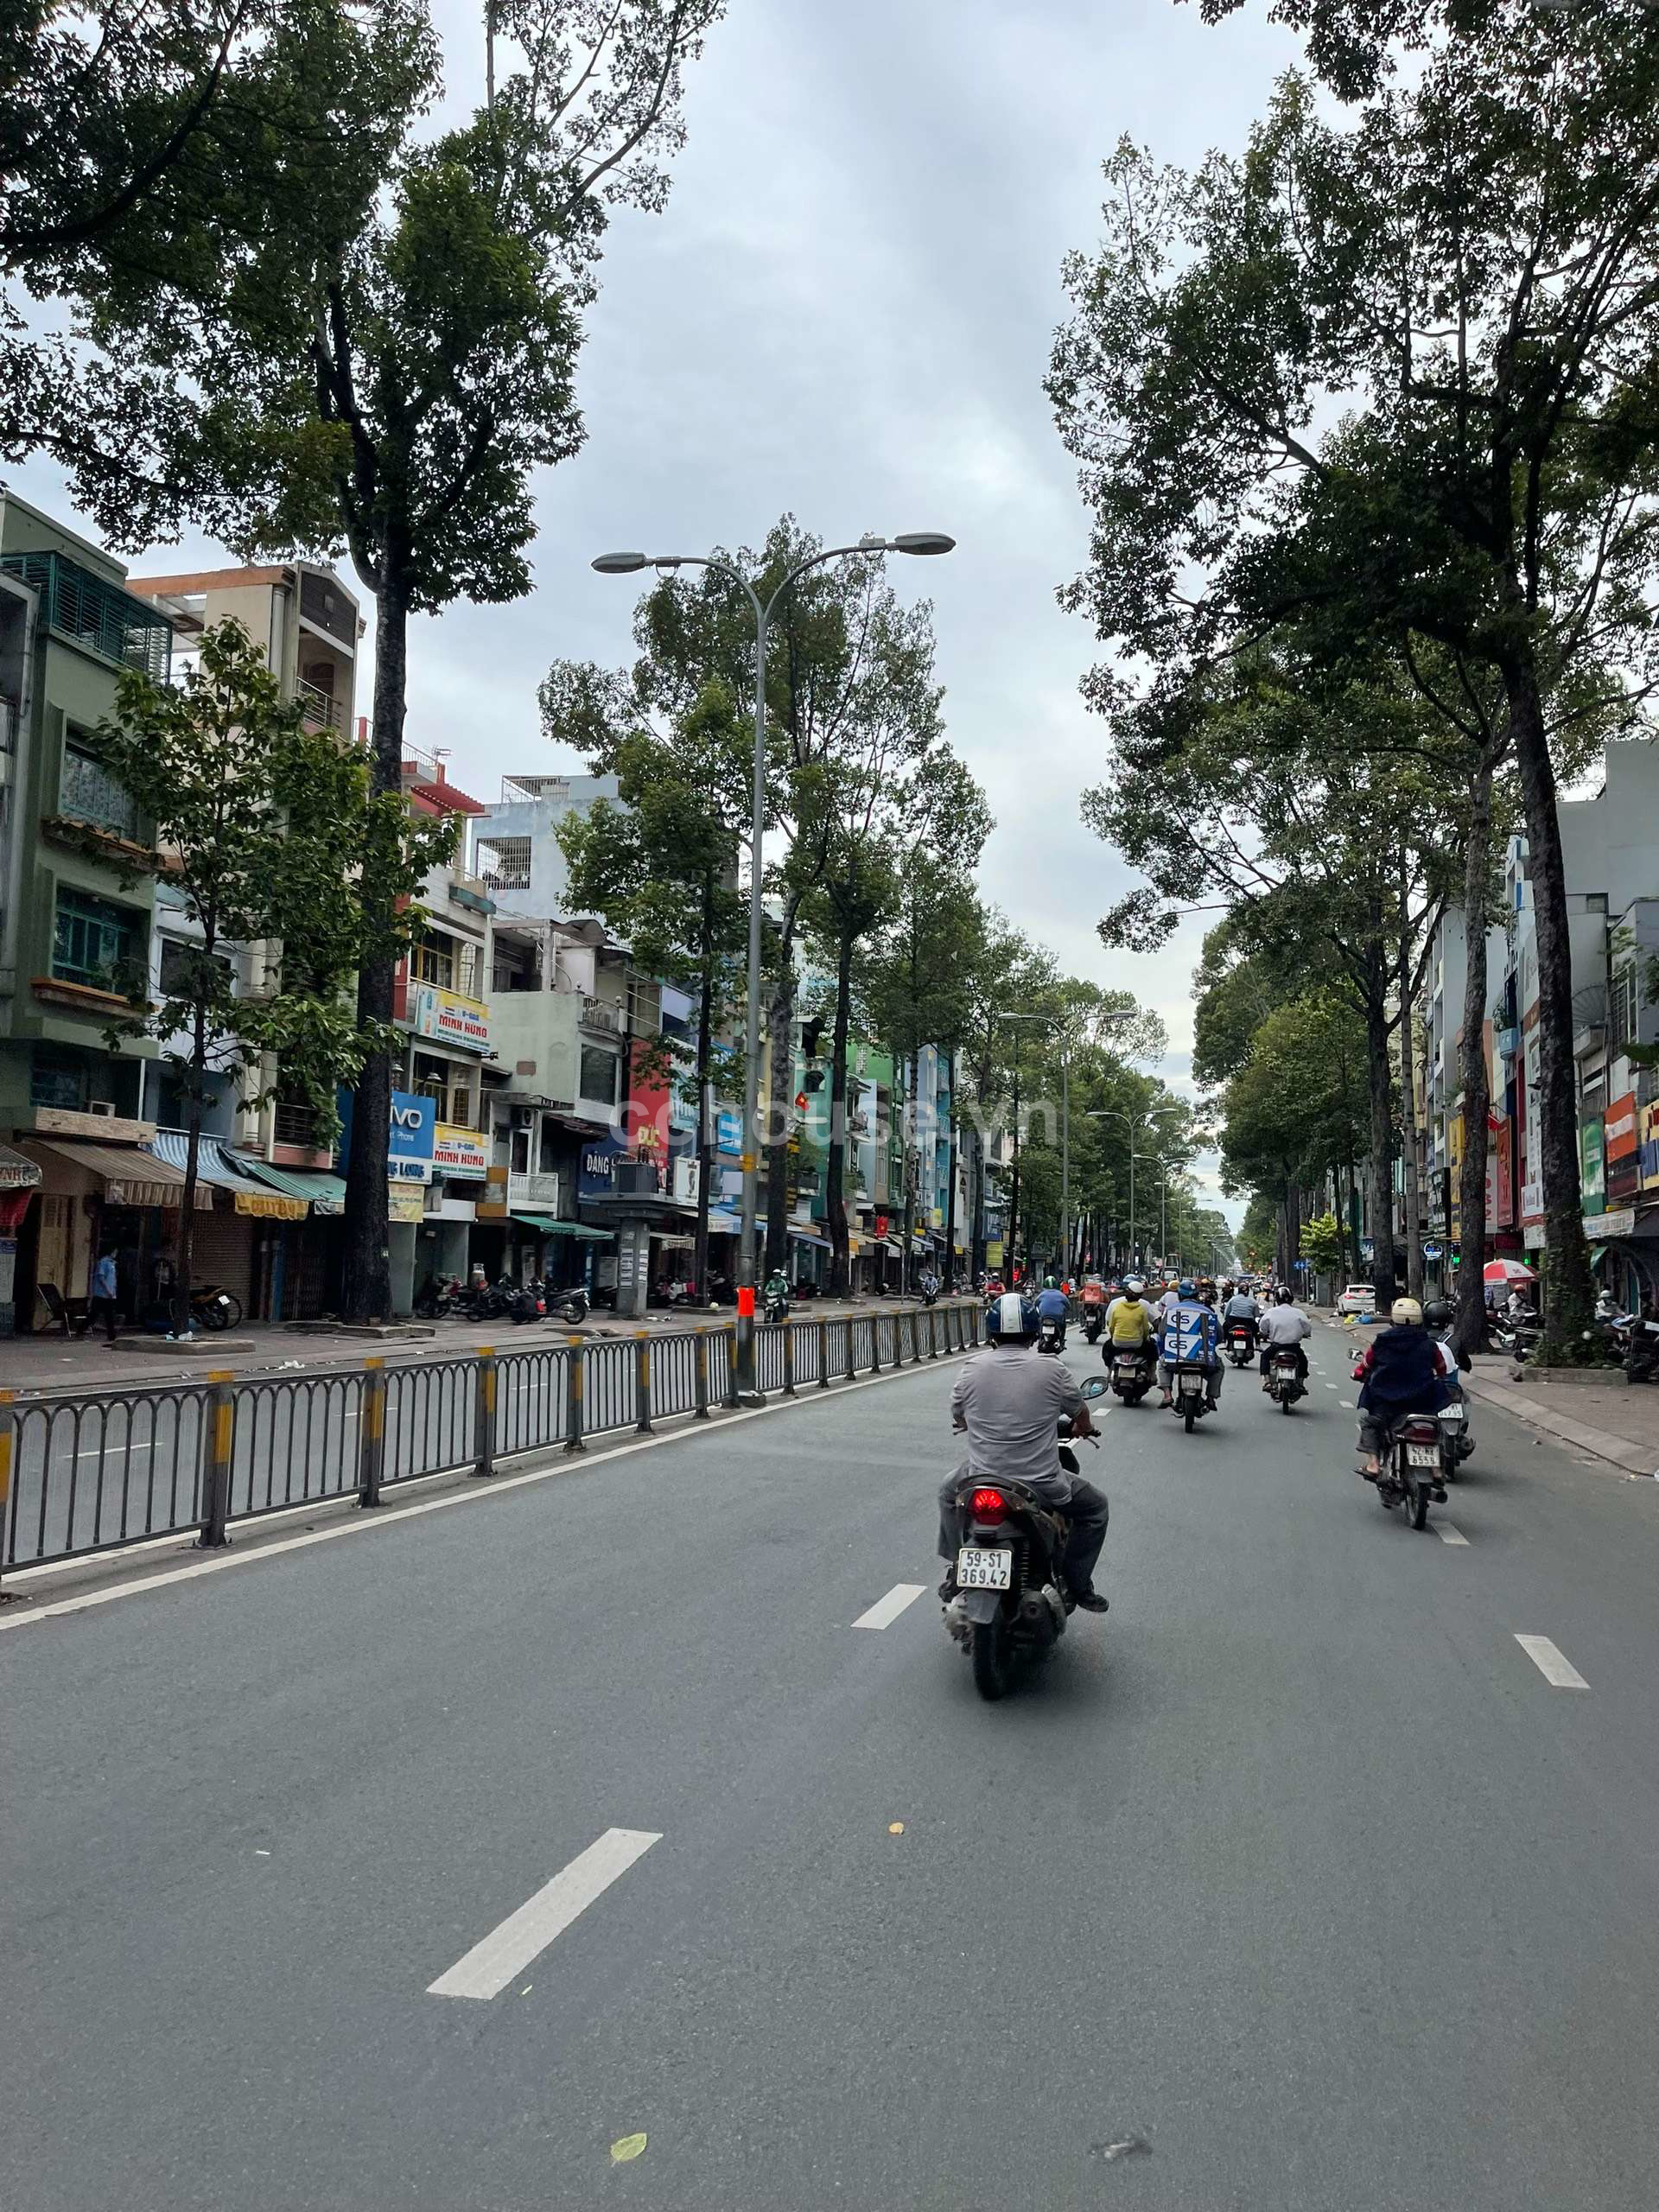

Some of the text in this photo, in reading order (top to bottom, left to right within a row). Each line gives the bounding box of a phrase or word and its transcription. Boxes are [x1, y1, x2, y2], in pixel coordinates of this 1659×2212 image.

[439, 1014, 463, 1033] MINH
[390, 1098, 423, 1129] ivo
[435, 1150, 459, 1164] MINH
[967, 1552, 1002, 1568] 59-S1
[961, 1568, 1007, 1586] 369.42
